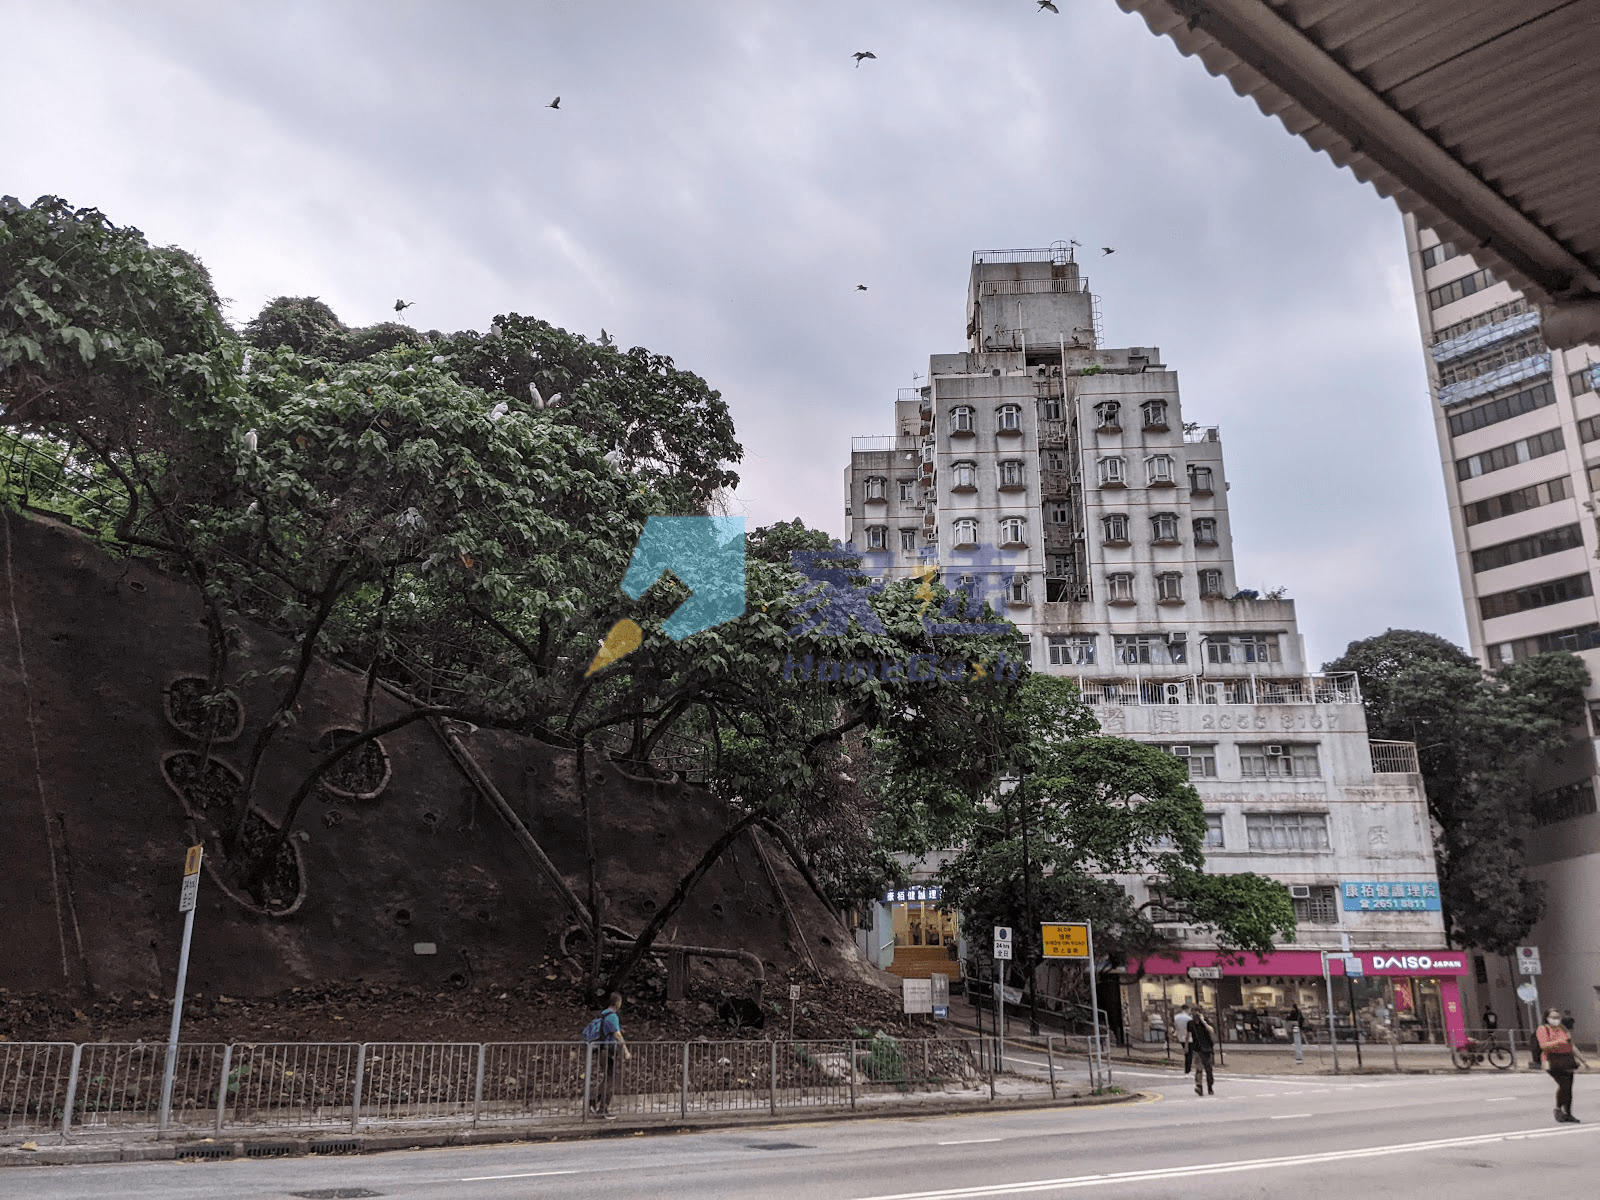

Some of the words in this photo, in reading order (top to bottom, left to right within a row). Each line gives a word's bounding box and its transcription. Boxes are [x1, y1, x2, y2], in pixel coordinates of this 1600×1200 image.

[887, 889, 943, 901] 康栢健護理
[1373, 900, 1398, 909] 2651
[1373, 956, 1432, 969] DAISO
